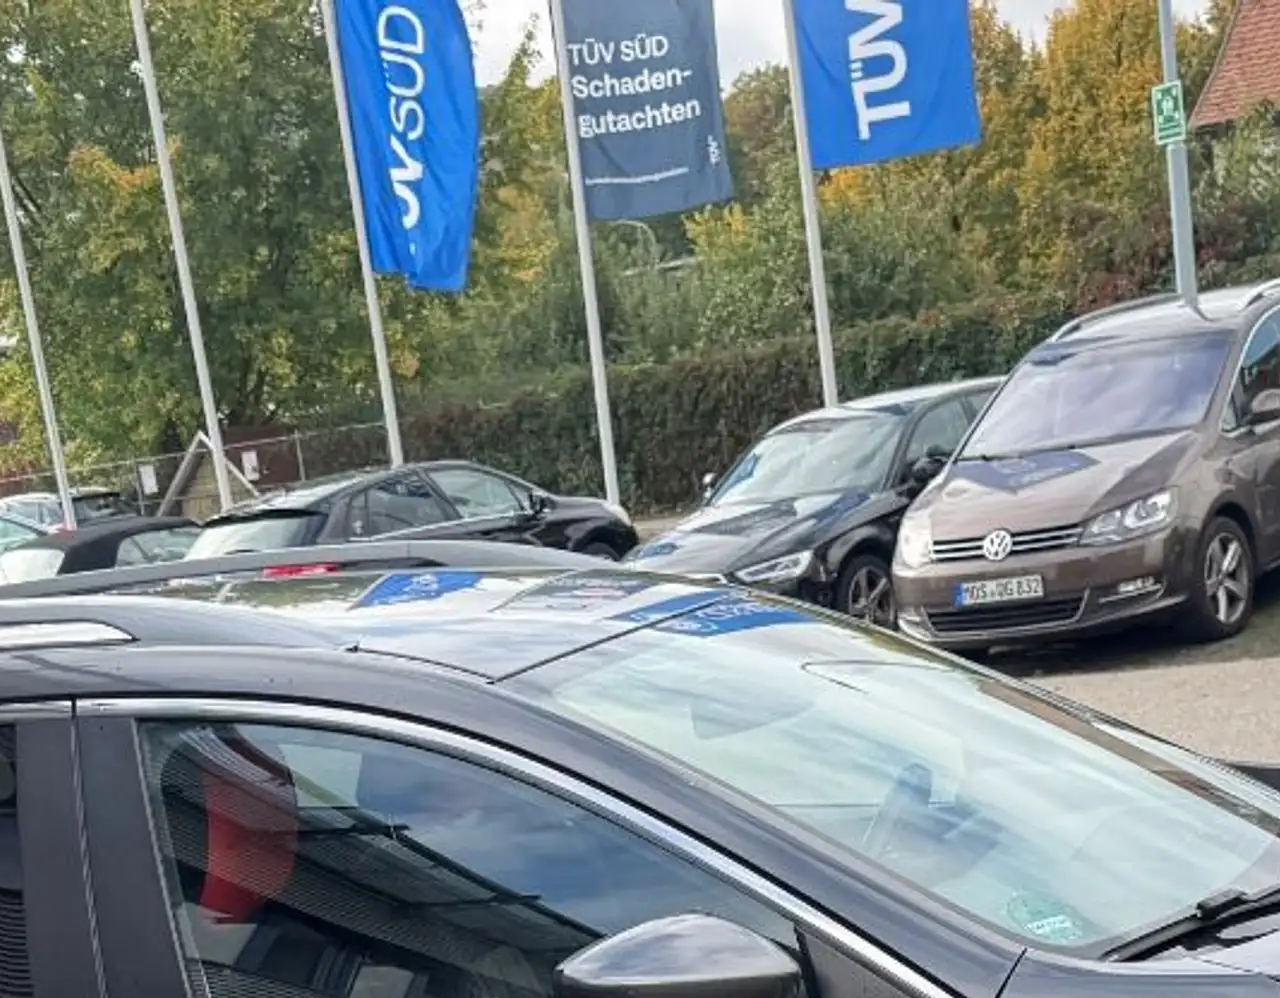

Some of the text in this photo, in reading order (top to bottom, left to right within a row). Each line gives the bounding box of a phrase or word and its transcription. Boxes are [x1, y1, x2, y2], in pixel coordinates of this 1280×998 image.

[567, 33, 669, 67] TÜV SÜD
[376, 4, 425, 141] SÜD
[571, 67, 694, 99] Schaden-
[844, 0, 911, 141] TÜV
[578, 99, 702, 139] gutachten
